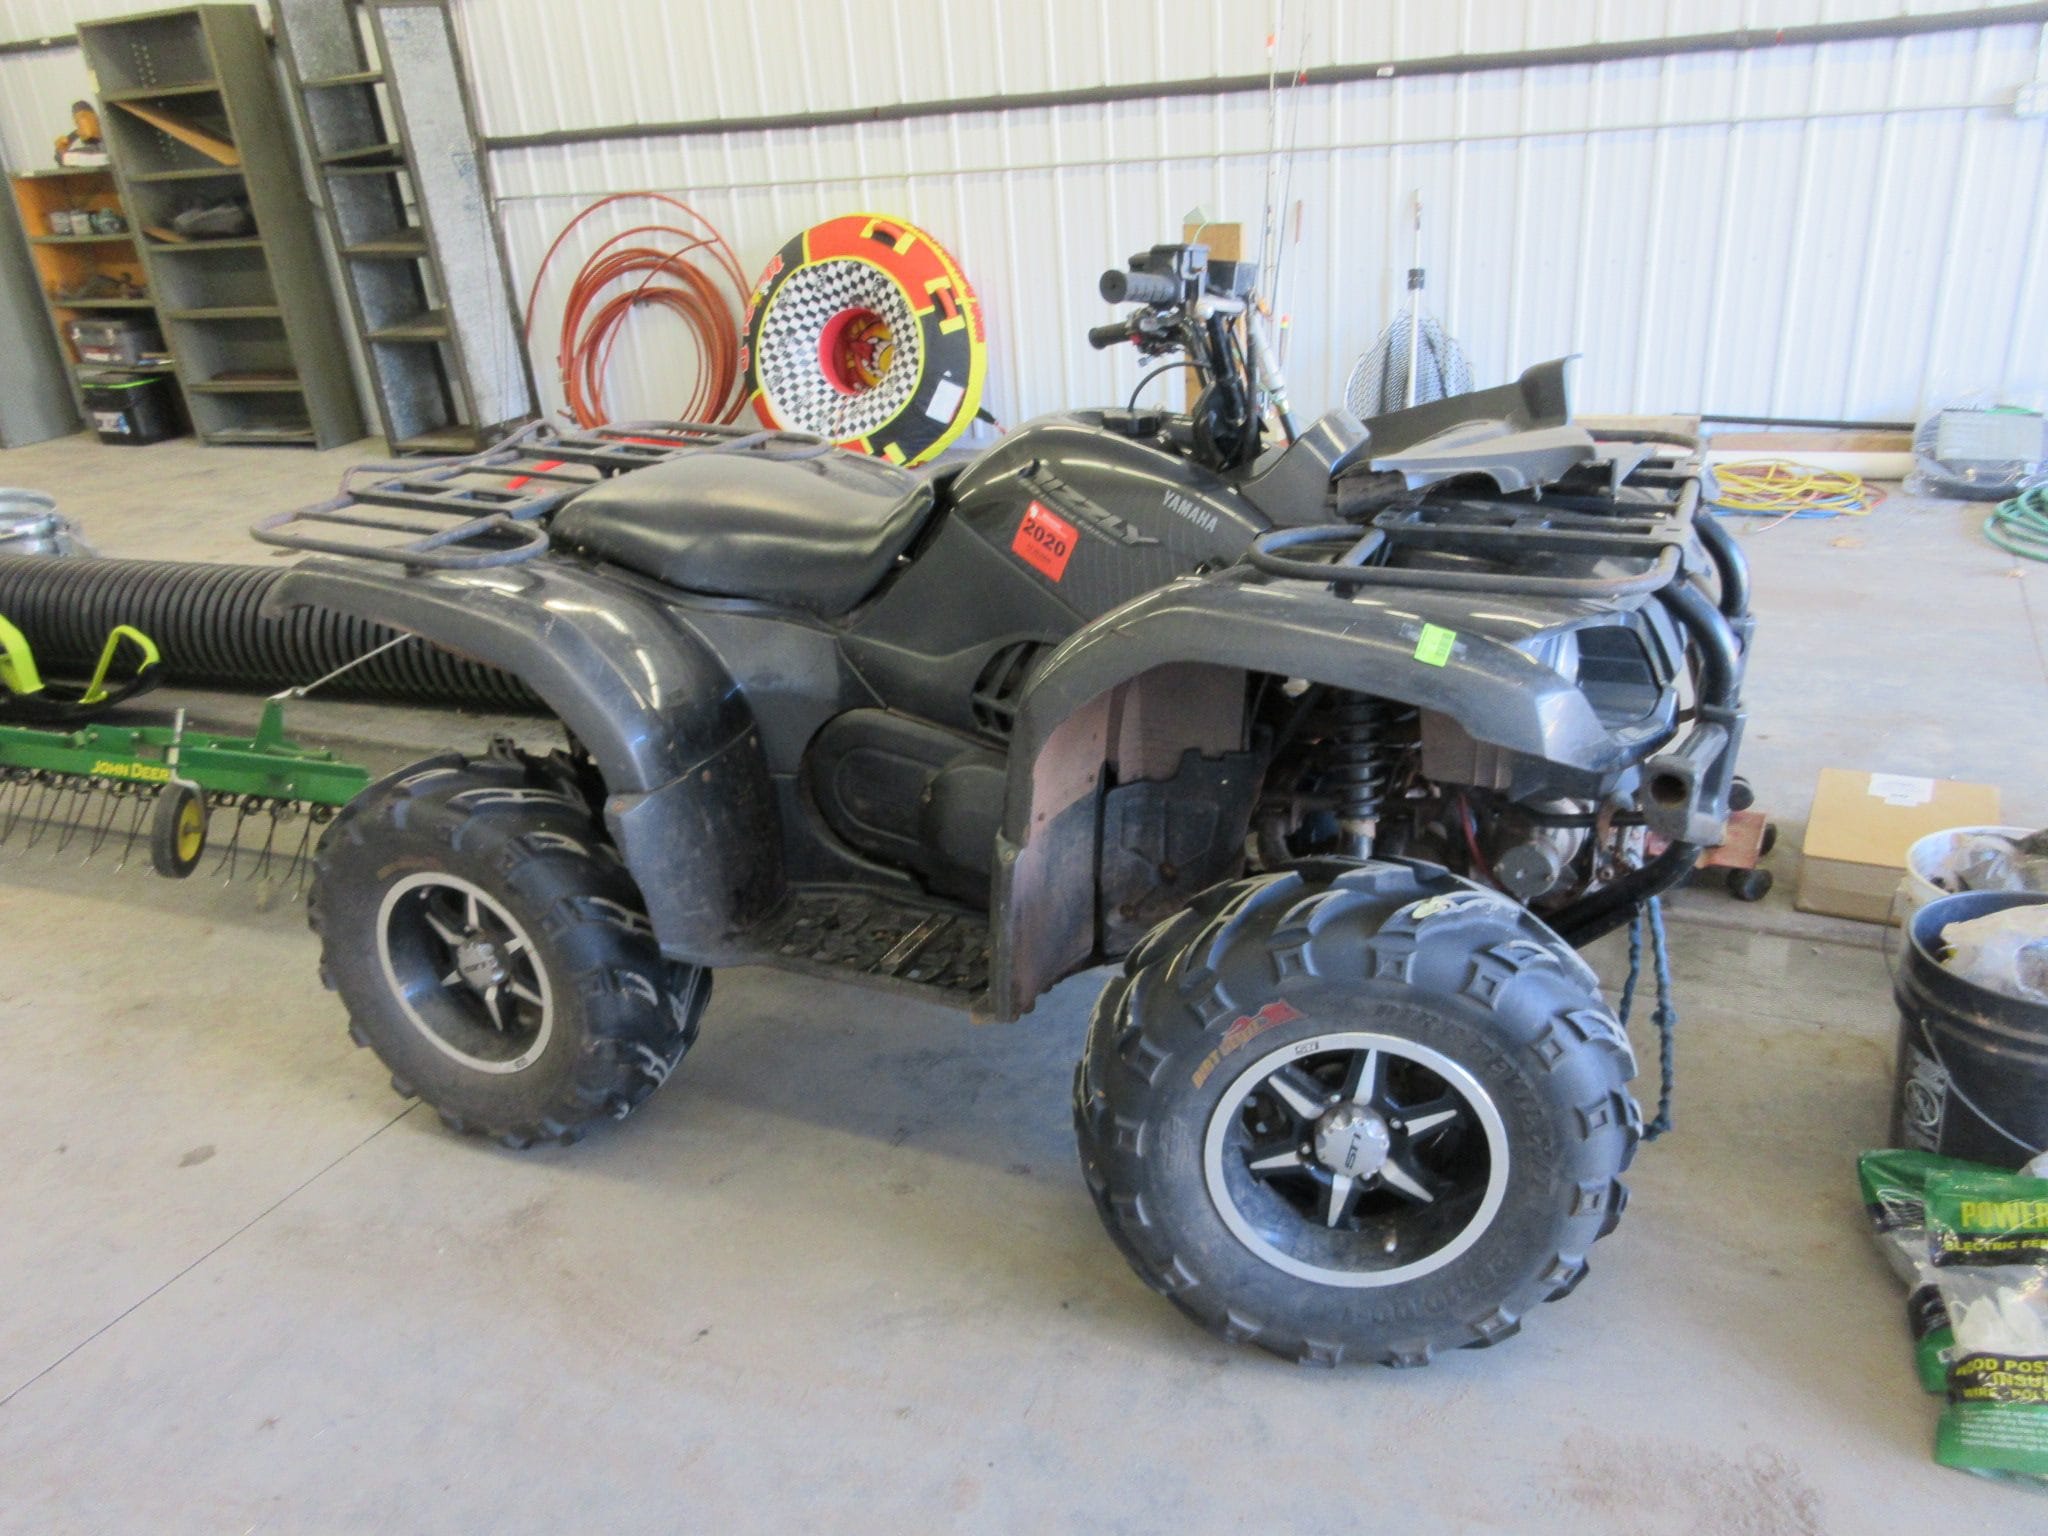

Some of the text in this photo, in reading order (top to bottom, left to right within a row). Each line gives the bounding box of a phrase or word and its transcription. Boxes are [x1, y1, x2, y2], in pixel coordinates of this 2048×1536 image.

[1163, 489, 1219, 533] YAMAHA
[1023, 517, 1067, 557] 2020
[130, 762, 170, 782] DEER
